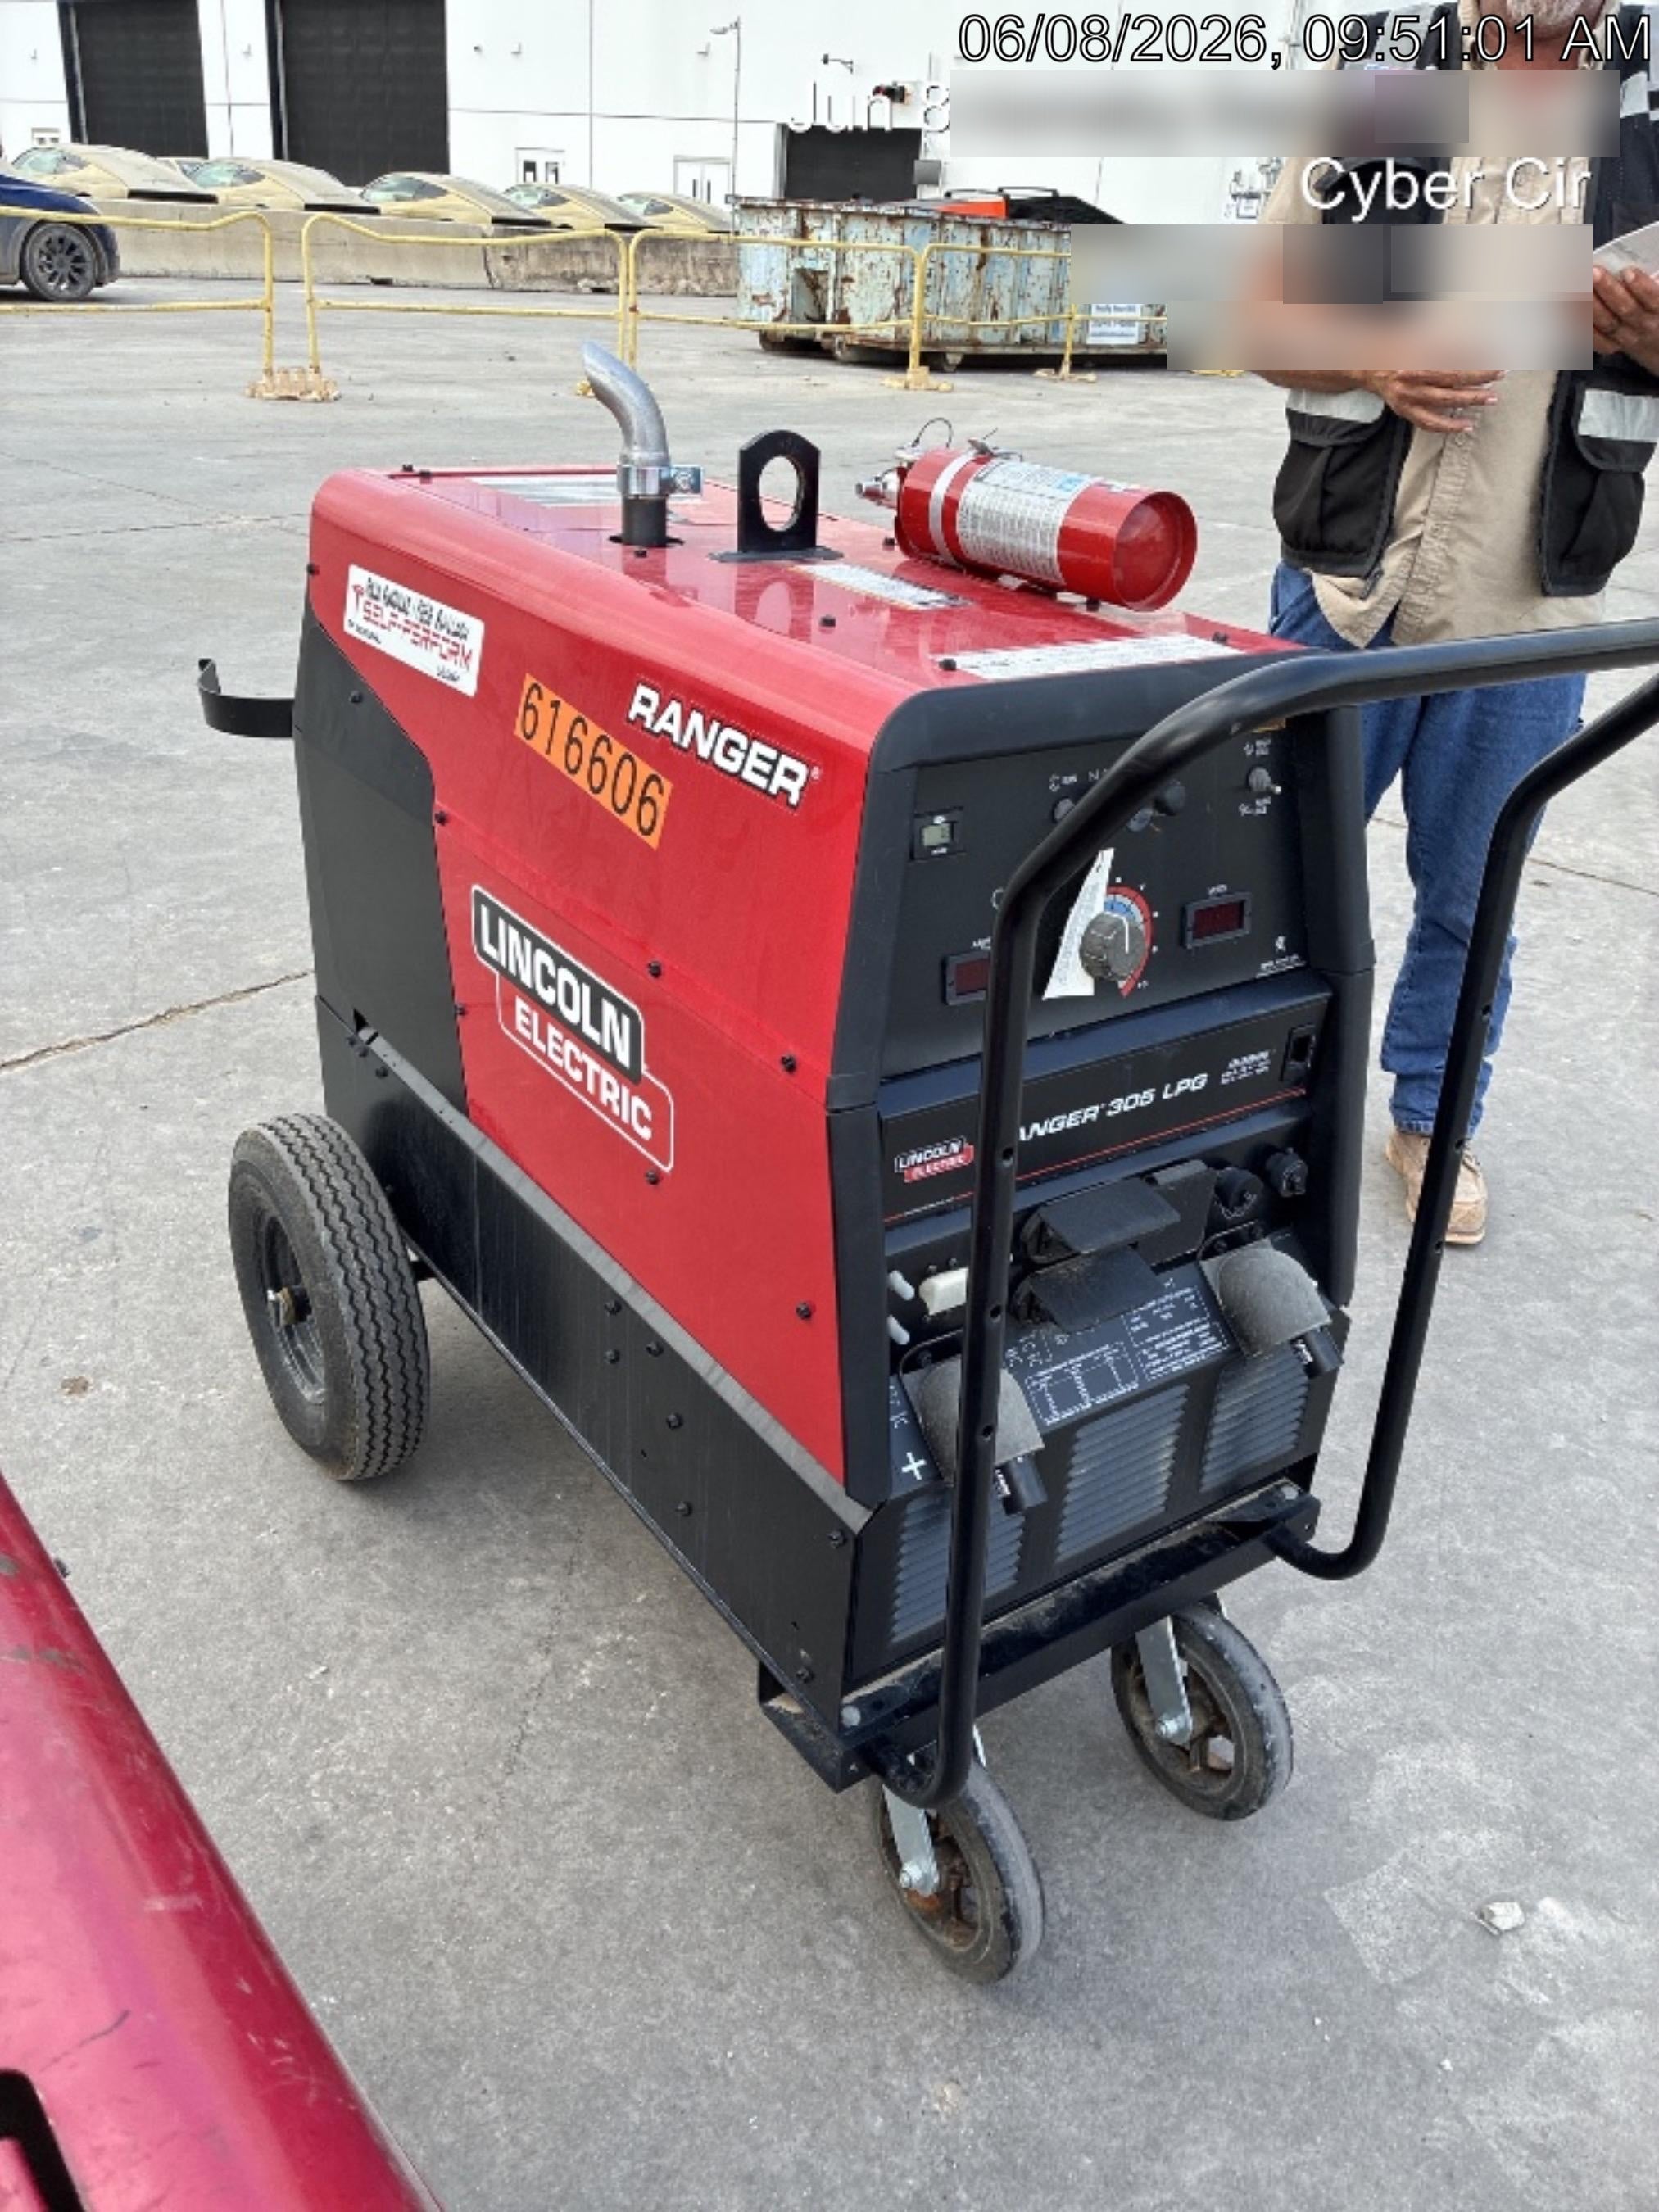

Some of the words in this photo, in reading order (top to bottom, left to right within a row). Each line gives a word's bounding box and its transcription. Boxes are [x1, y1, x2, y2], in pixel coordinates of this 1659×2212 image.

[520, 682, 665, 836] 616606
[480, 904, 632, 1070] LINCOLN
[514, 994, 653, 1142] ELECTRIC
[1106, 1088, 1156, 1117] 305
[1162, 1072, 1209, 1100] LPG
[898, 1139, 963, 1170] LINCOLN
